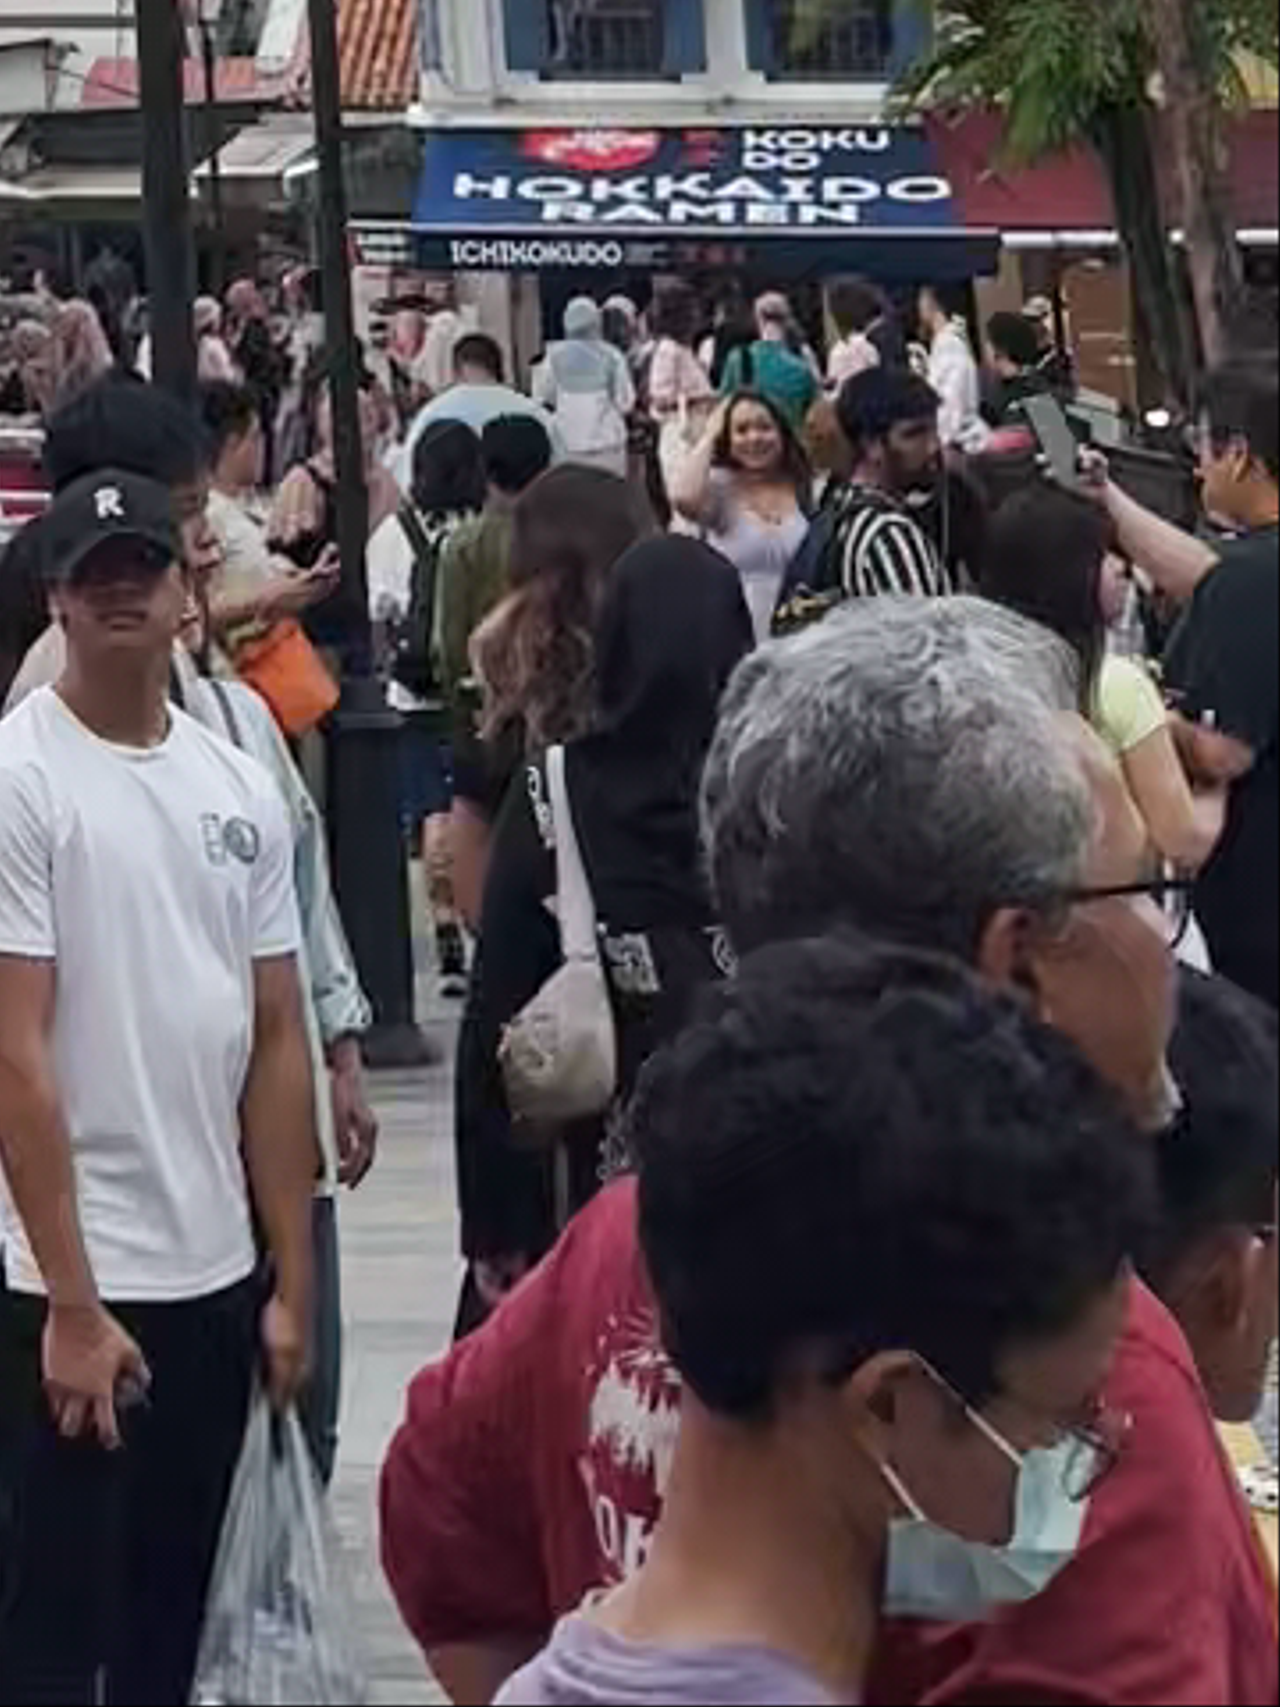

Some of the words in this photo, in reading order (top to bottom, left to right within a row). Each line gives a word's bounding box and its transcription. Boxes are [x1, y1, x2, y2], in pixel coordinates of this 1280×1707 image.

[743, 130, 889, 150] KOKU
[743, 151, 821, 170] DO
[453, 173, 952, 201] HOKKAIDO
[541, 201, 859, 224] RAMEN
[450, 240, 622, 264] ICHIKOKUDO
[94, 487, 124, 519] R
